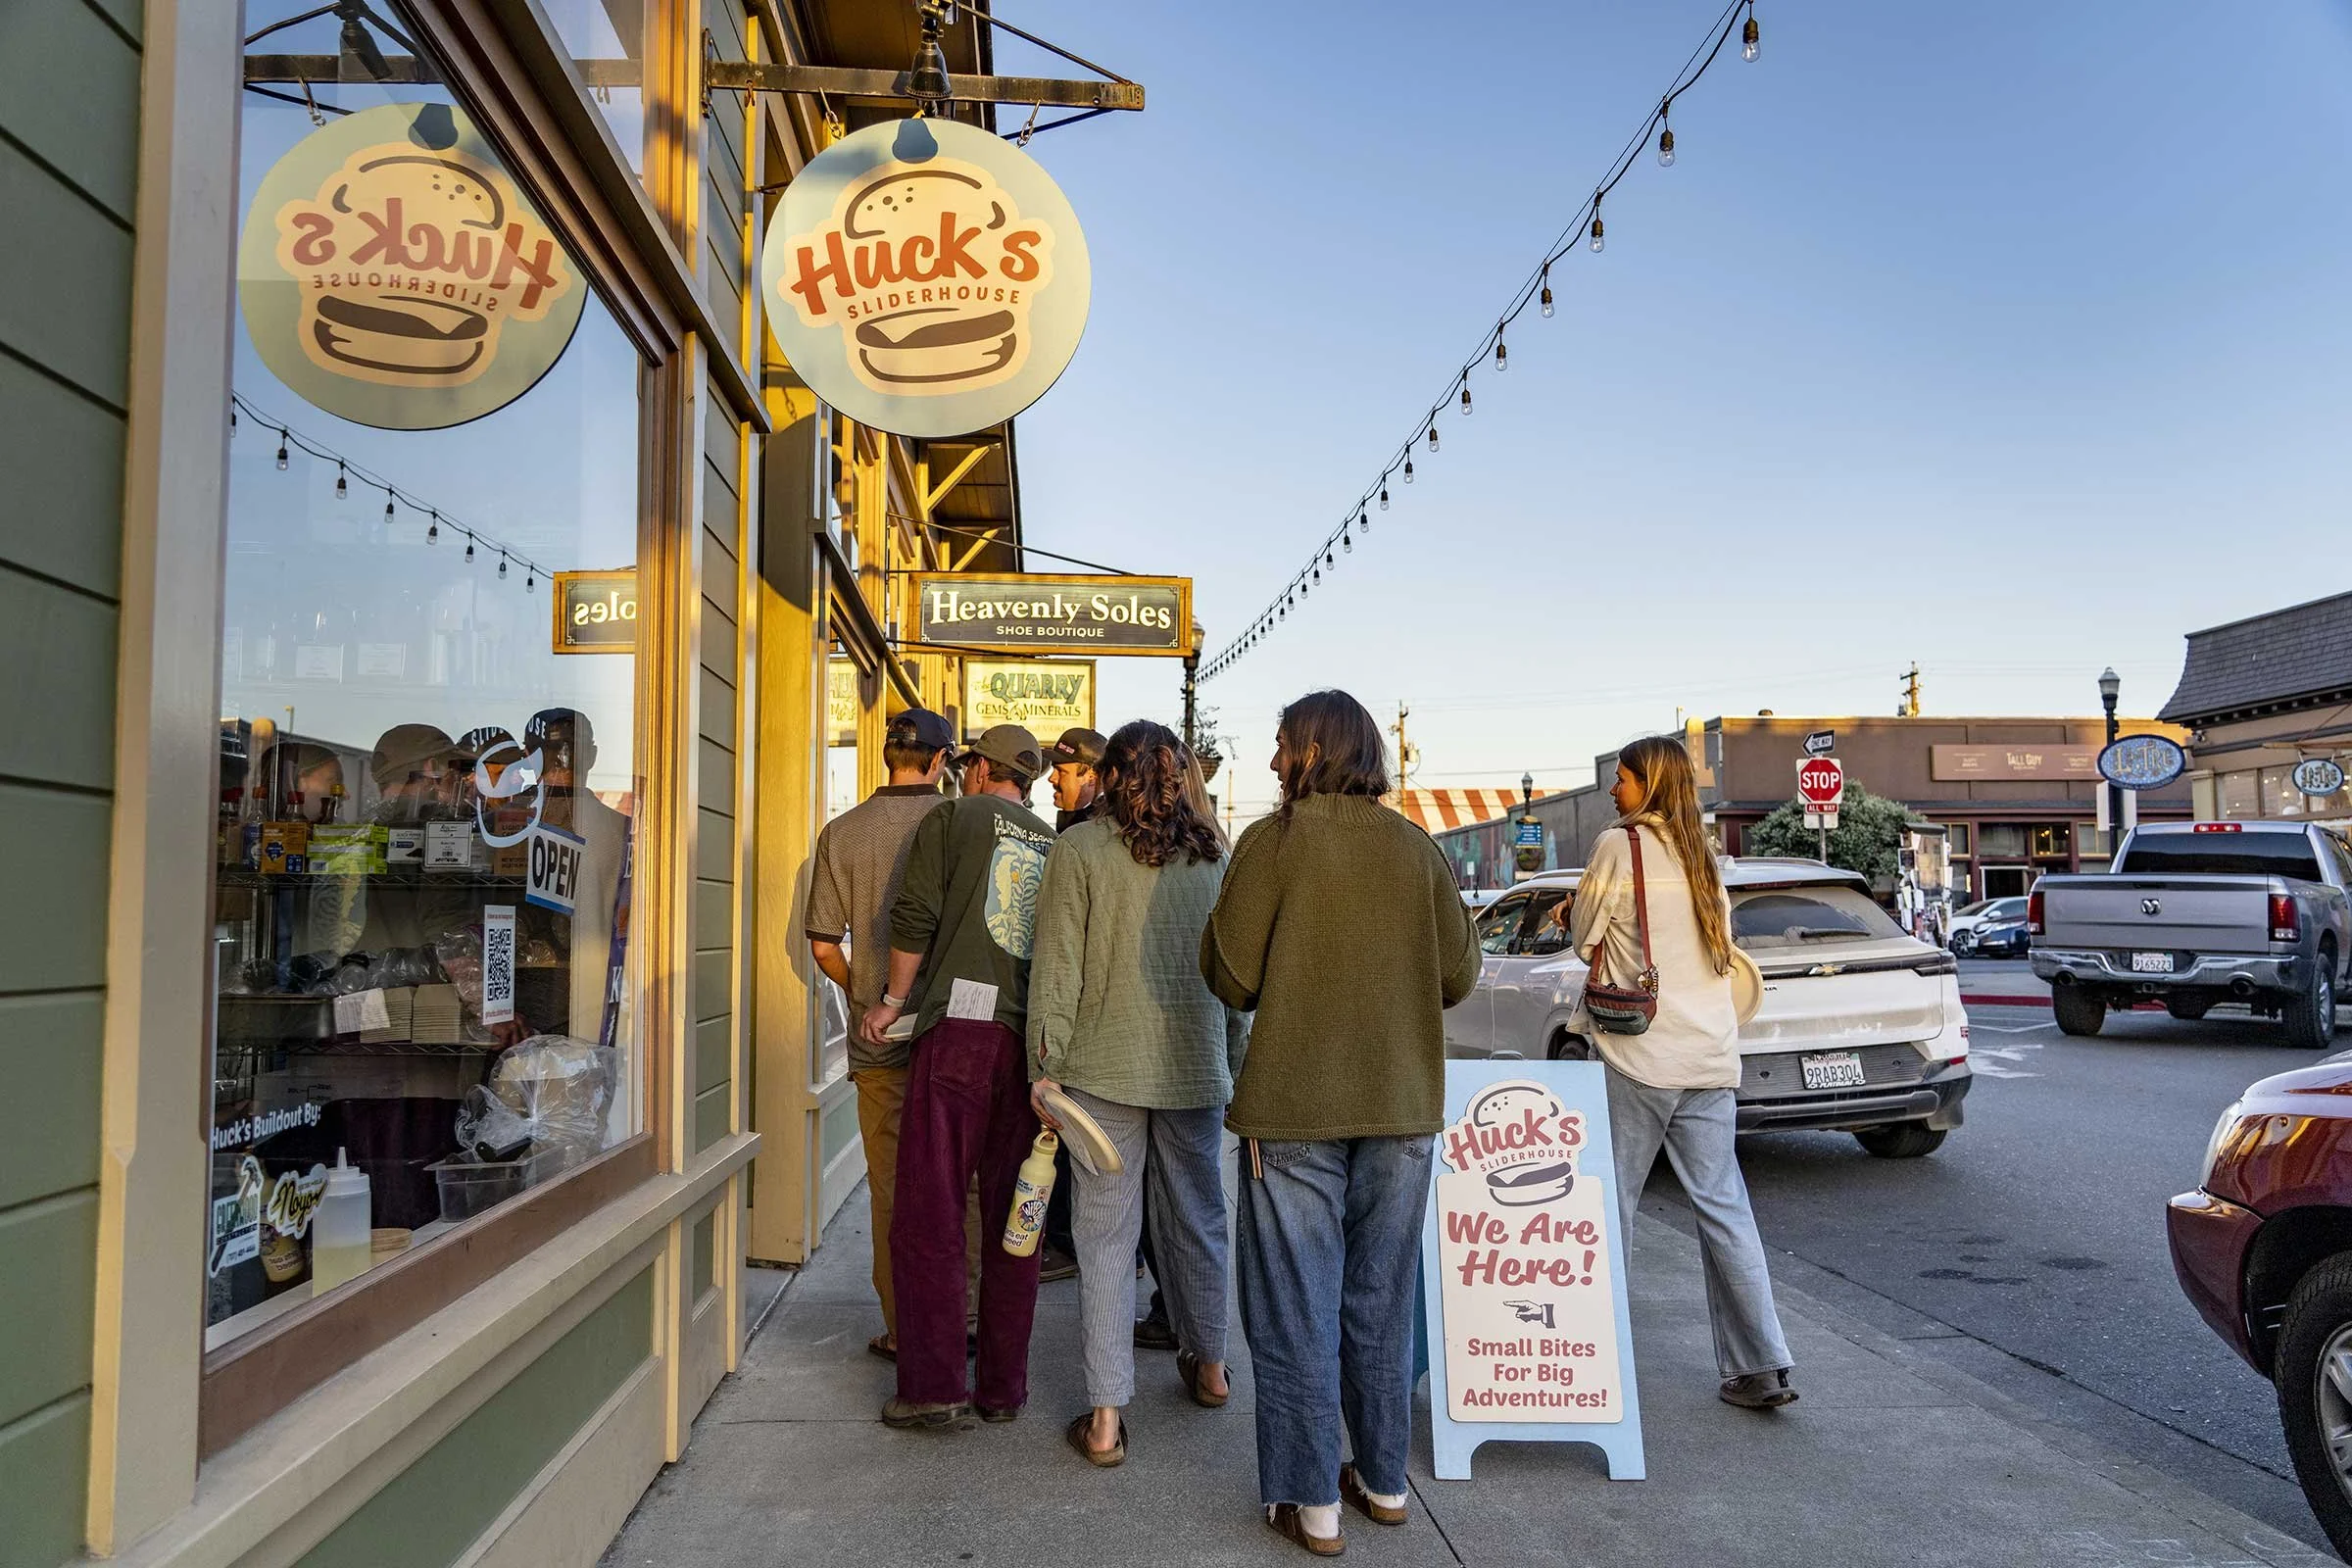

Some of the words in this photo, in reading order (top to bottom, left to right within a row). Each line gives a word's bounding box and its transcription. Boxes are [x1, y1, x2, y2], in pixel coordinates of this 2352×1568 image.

[791, 204, 1042, 316] Huck's
[848, 286, 1020, 319] SLIDERHOUSE
[929, 590, 1082, 629] Heavenly
[1091, 594, 1171, 630] Soles
[997, 625, 1033, 636] SHOE
[1037, 626, 1104, 638] BOUTIQUE
[991, 672, 1085, 705] QUARRY
[976, 702, 1008, 715] GEMS
[1023, 704, 1081, 717] MINERALS
[2006, 753, 2025, 765] TALL
[2026, 753, 2042, 766] GUY
[1802, 771, 1839, 789] STOP
[994, 818, 1027, 842] CALIFORNIA
[532, 835, 580, 901] OPEN
[1806, 1064, 1860, 1085] 9RAB304
[210, 1118, 251, 1150] Huck's
[253, 1105, 303, 1139] Buildout
[304, 1102, 321, 1126] By:
[1448, 1104, 1582, 1171] Huck's
[1480, 1150, 1573, 1172] SLIDERHOUSE
[1446, 1210, 1509, 1245] We
[1520, 1211, 1599, 1246] Are
[1457, 1250, 1596, 1287] Here!
[1467, 1338, 1532, 1357] Small
[1540, 1338, 1595, 1357] Bites
[1494, 1363, 1532, 1382] For
[1538, 1363, 1574, 1387] Big
[1462, 1388, 1607, 1408] Adventures!
